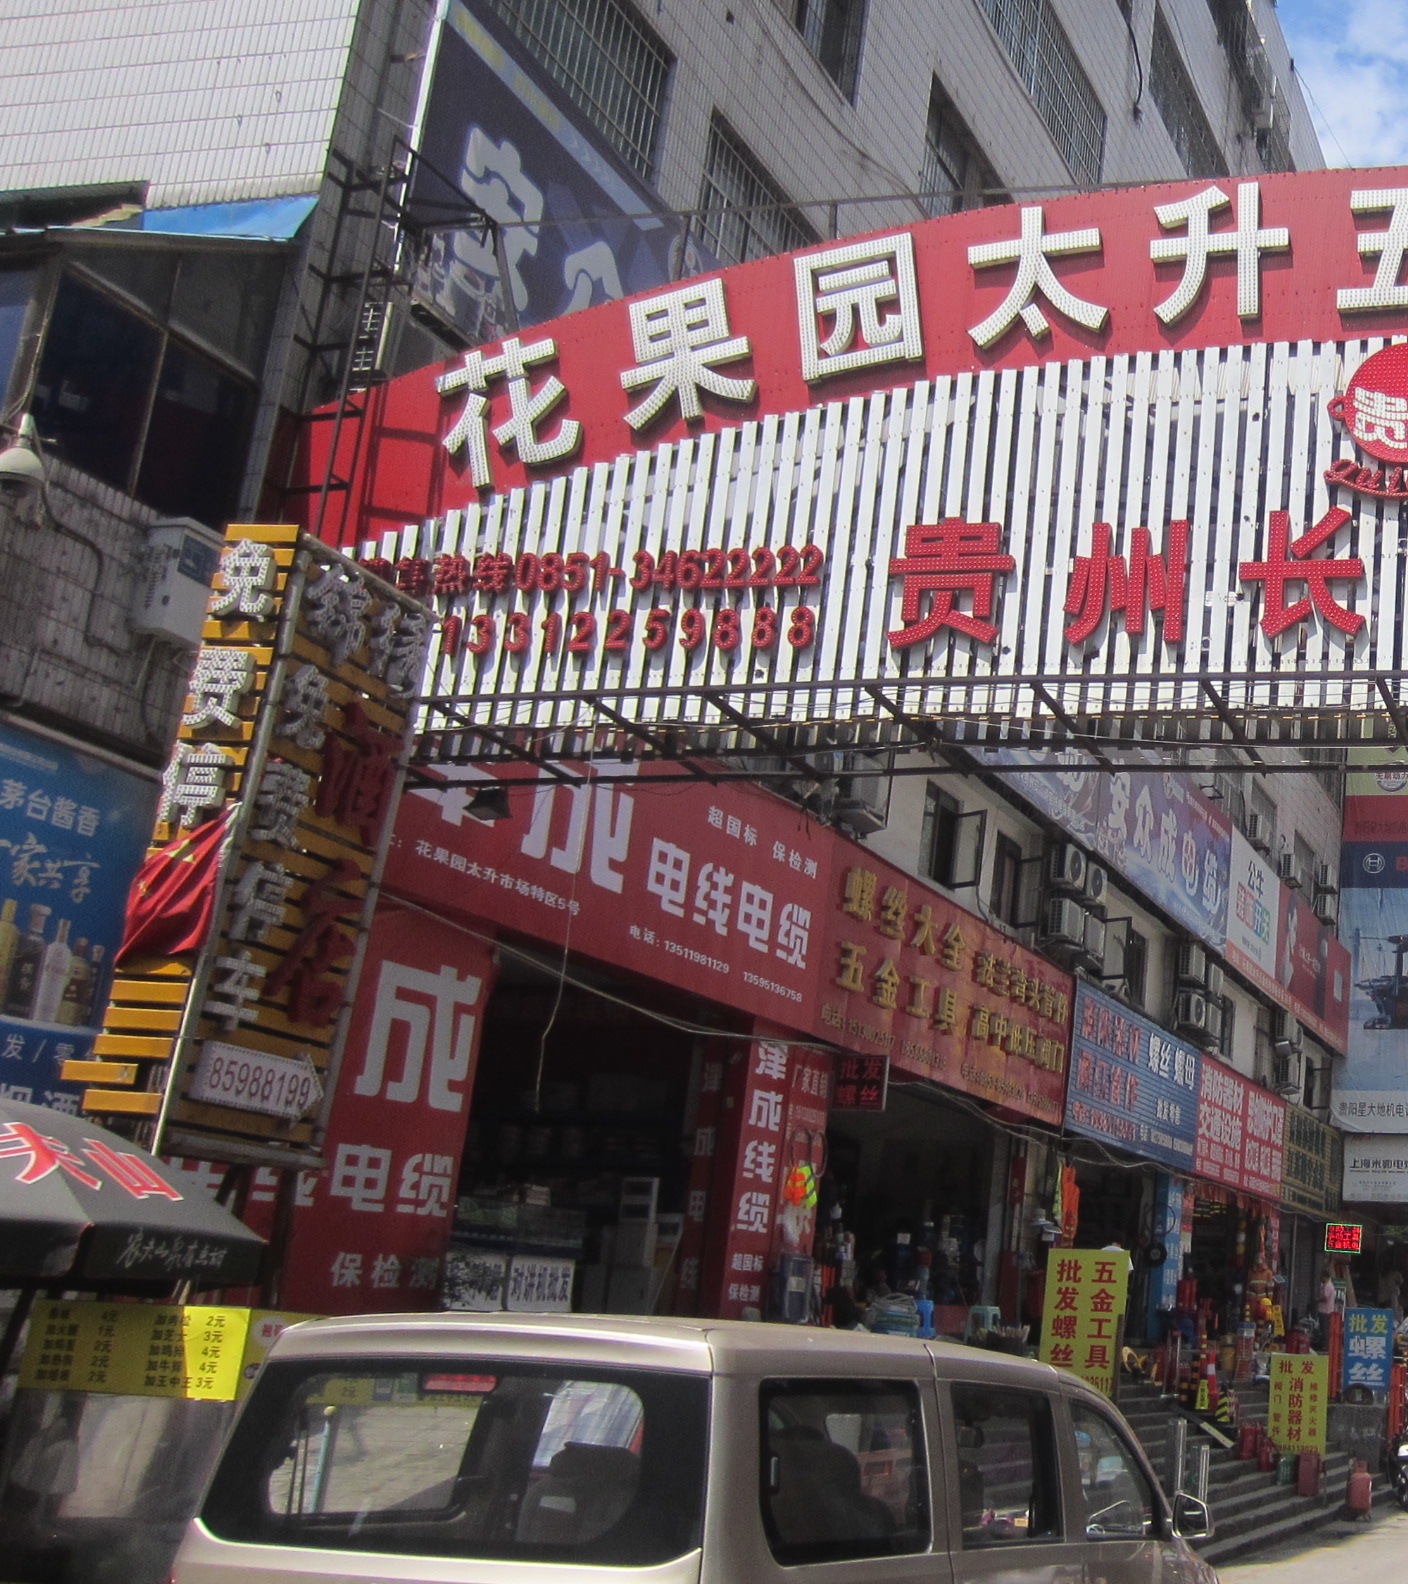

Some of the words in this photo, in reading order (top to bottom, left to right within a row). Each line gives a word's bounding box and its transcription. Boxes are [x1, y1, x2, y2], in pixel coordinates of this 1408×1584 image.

[441, 605, 817, 656] 13312259888
[707, 803, 758, 848] 超国标
[772, 839, 818, 879] 保检测
[415, 838, 582, 918] 花果园太升市场特区5号
[647, 837, 813, 970] 电线电缆
[842, 866, 967, 972] 螺丝大全
[835, 940, 960, 1036] 五金工具
[210, 1050, 311, 1104] 85988199
[737, 1041, 790, 1234] 津成线缆
[203, 1330, 223, 1343] 3元
[206, 1315, 226, 1328] 2元
[1050, 1259, 1083, 1369] 批发螺丝
[1084, 1261, 1118, 1370] 五金工具
[1349, 1314, 1388, 1334] 批发
[199, 1361, 218, 1374] 4元
[201, 1346, 221, 1358] 4元
[1279, 1360, 1315, 1375] 批发
[1348, 1336, 1388, 1387] 螺丝
[196, 1376, 214, 1389] 3元
[1287, 1377, 1304, 1442] 消防器材
